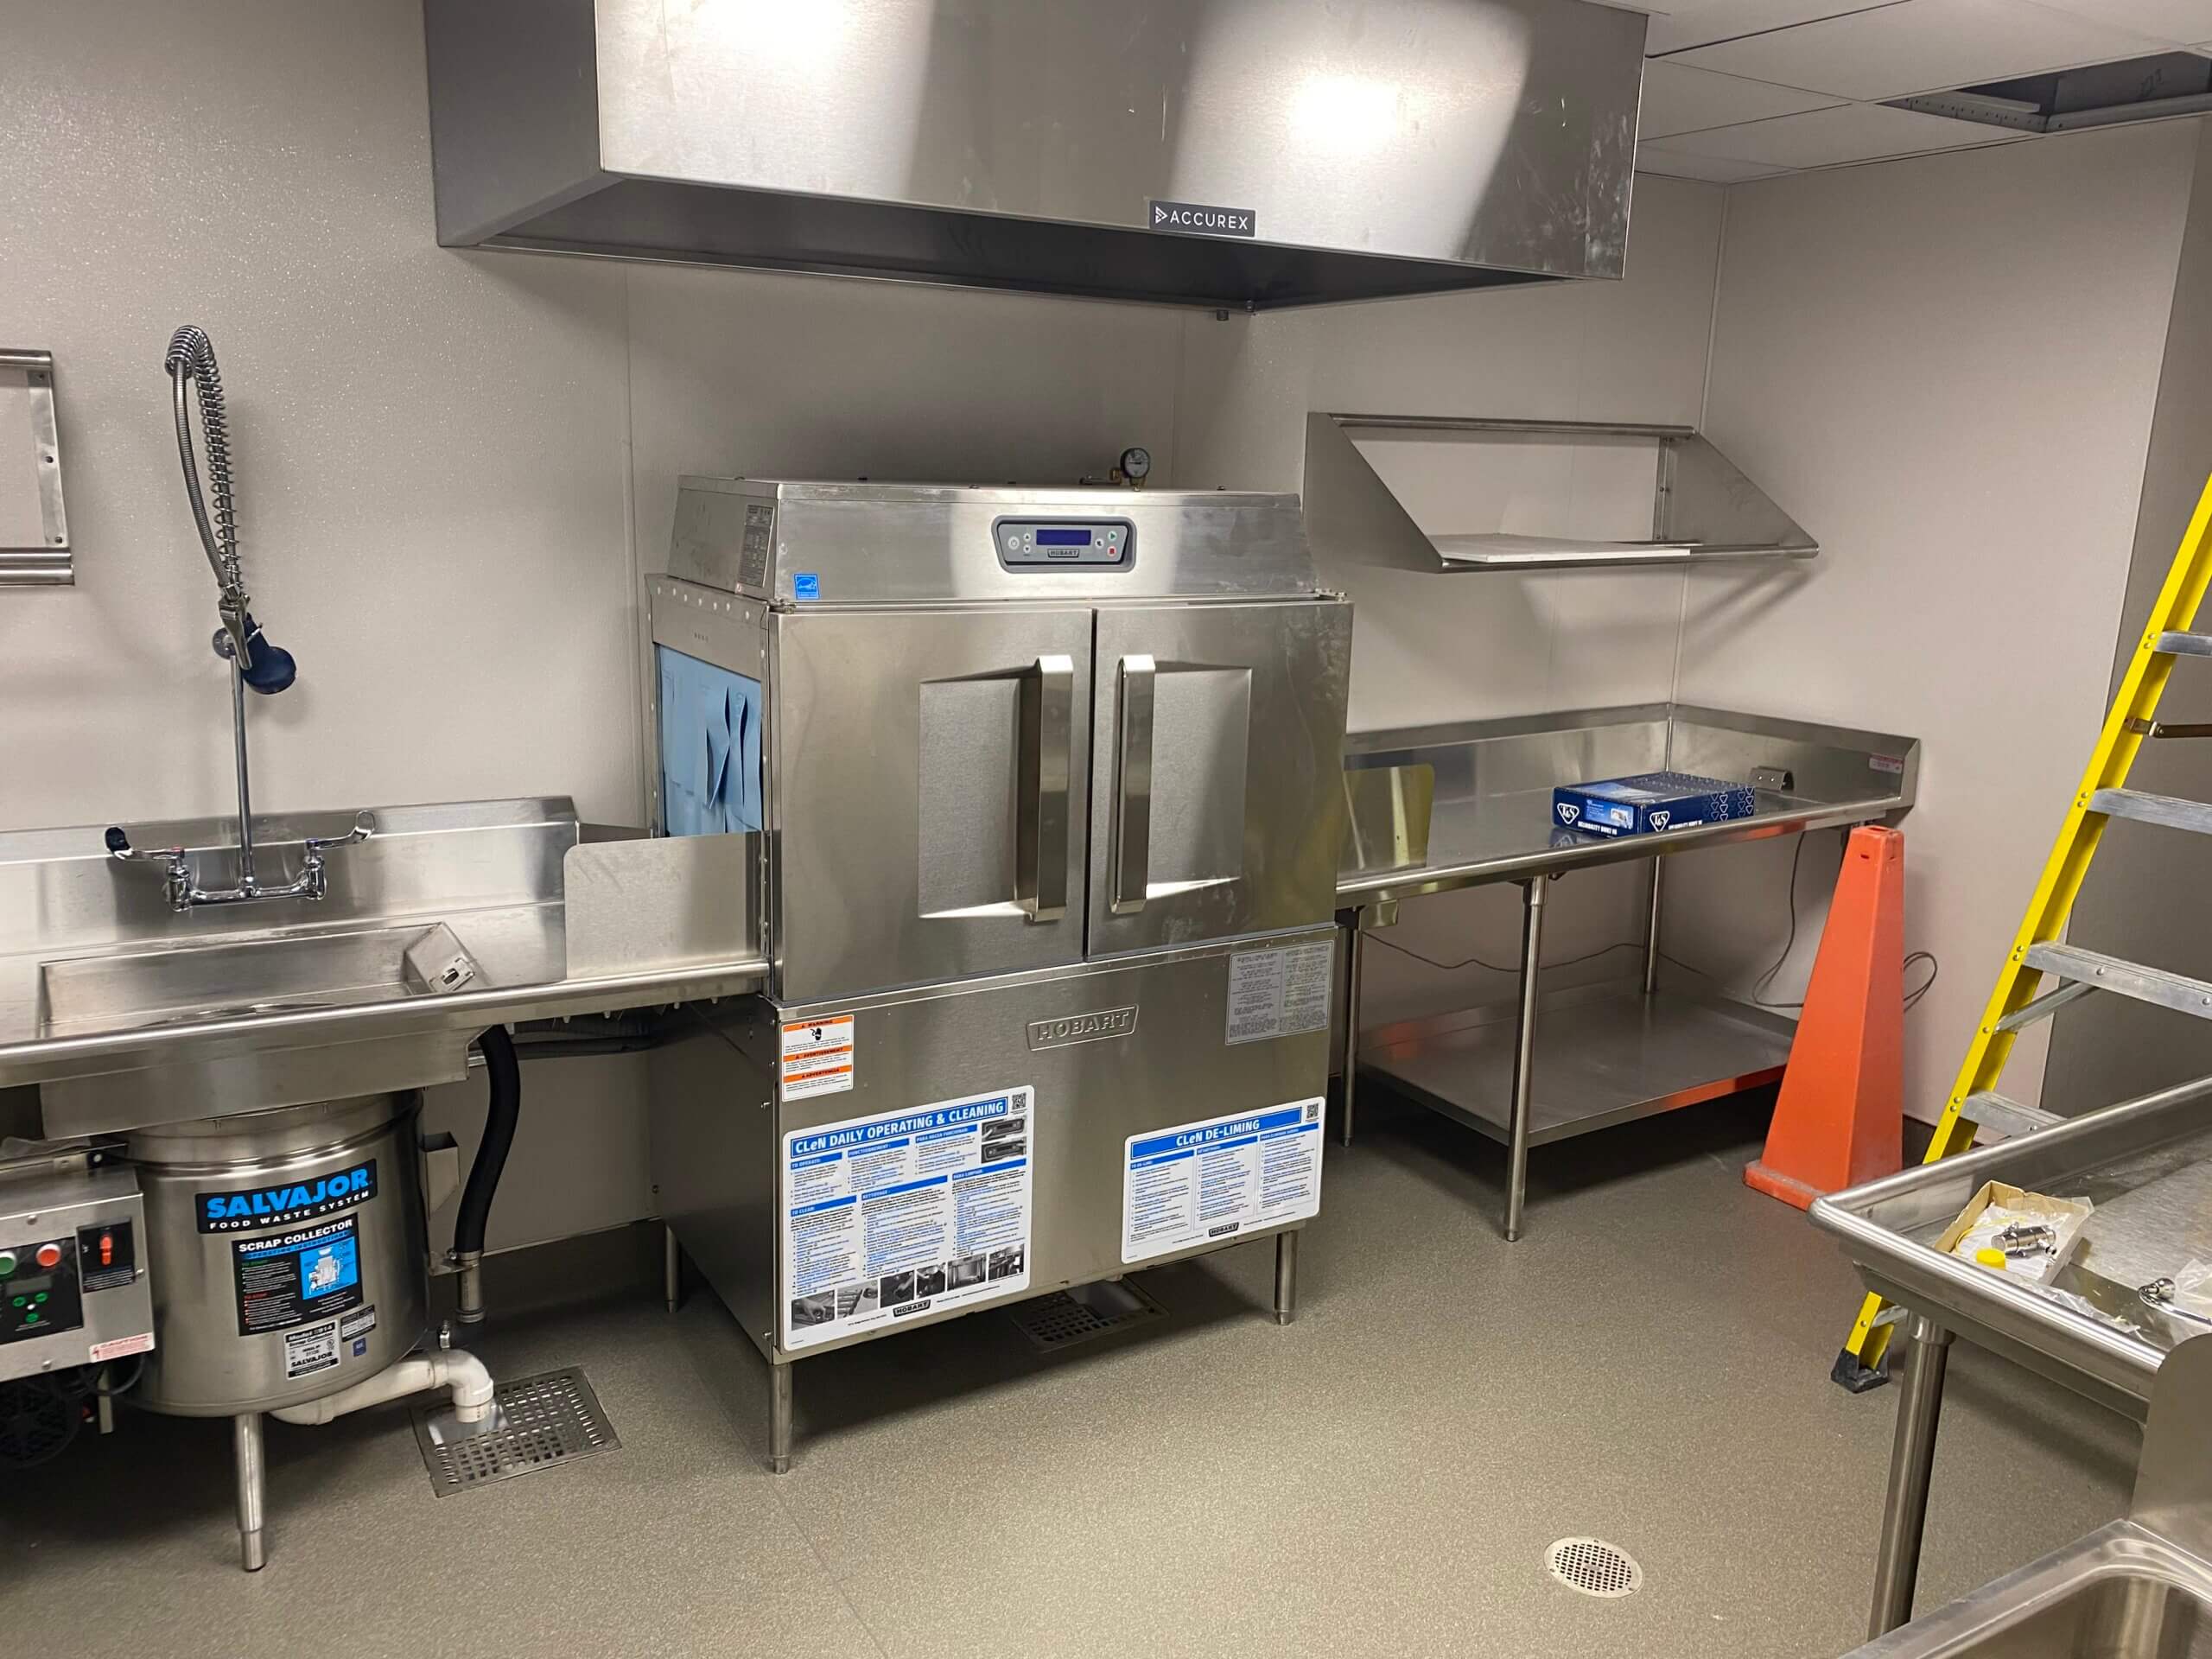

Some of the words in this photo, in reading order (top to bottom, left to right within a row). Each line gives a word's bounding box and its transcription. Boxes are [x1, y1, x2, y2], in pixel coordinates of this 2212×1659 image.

[1170, 210, 1248, 230] ACCUREX
[1038, 1011, 1129, 1040] HOBART
[796, 1137, 826, 1154] CLeN
[830, 1130, 865, 1147] DAILY
[867, 1116, 933, 1138] OPERATING
[936, 1112, 945, 1124] &
[949, 1102, 1004, 1122] CLEANING
[1176, 1133, 1203, 1147] CLeN
[1205, 1120, 1260, 1140] DE-LIMING
[207, 1168, 368, 1218] SALVAJOR
[210, 1219, 251, 1230] FOOD
[260, 1209, 311, 1224] WASTE
[320, 1190, 369, 1212] SYSTEM
[238, 1239, 282, 1252] SCRAP
[284, 1219, 353, 1244] COLLECTOR
[897, 1301, 927, 1313] HOBART
[291, 1351, 332, 1367] SALVAJOR
